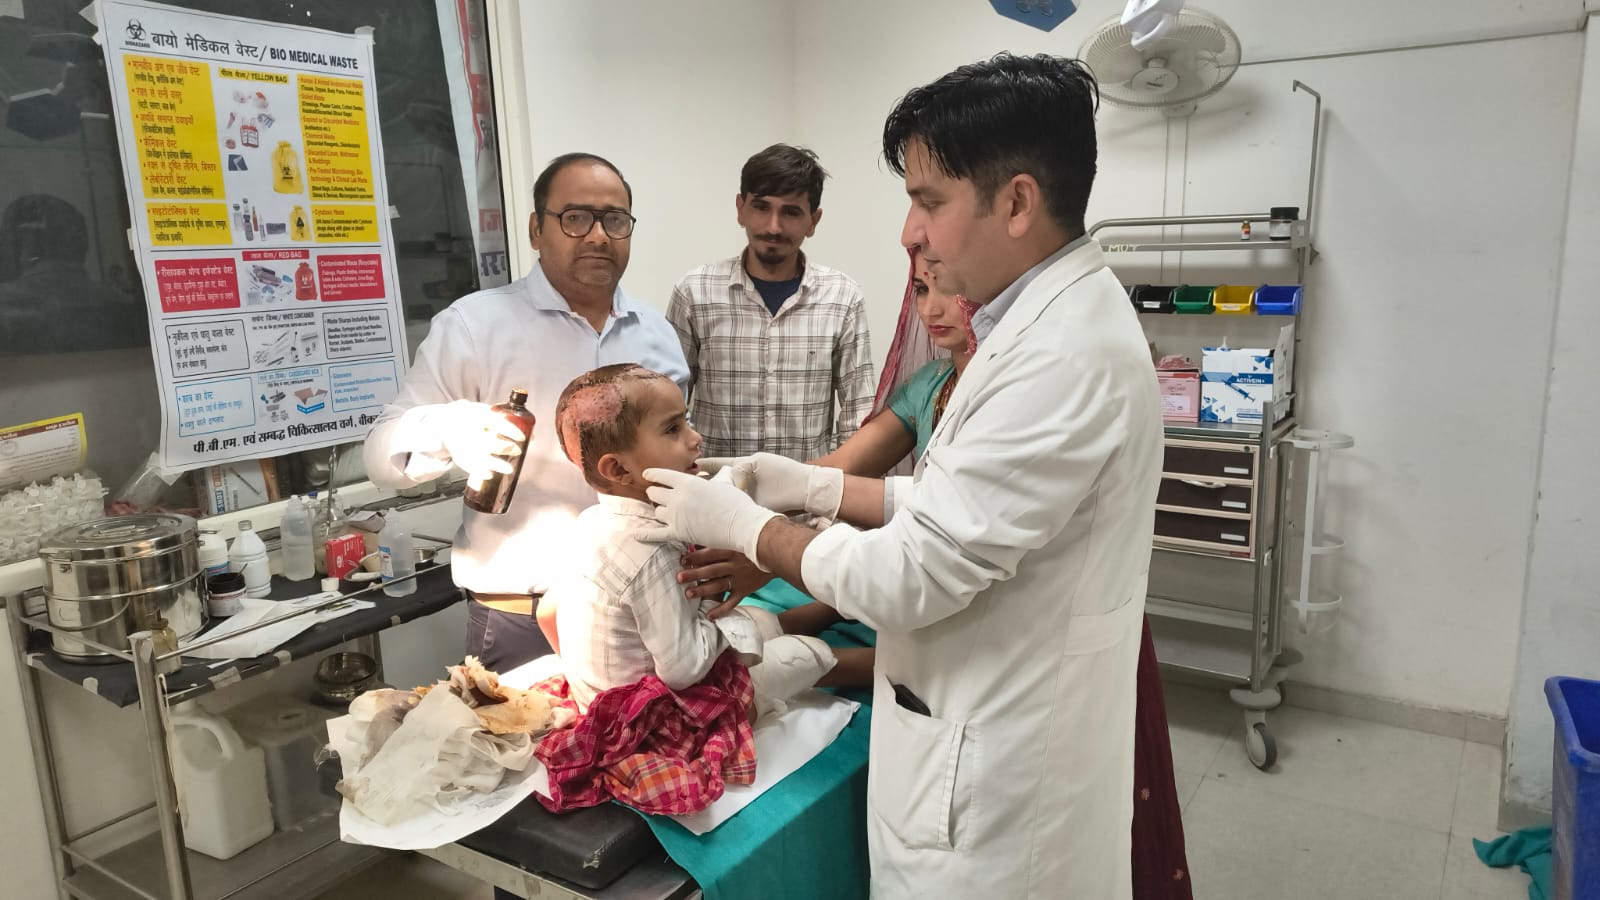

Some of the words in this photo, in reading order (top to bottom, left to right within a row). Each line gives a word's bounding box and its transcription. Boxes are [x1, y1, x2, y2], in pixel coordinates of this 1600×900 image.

[150, 30, 178, 48] बायो
[184, 32, 230, 55] मेडिकल
[270, 47, 286, 60] BIO
[289, 50, 328, 66] MEDICAL
[329, 55, 358, 69] WASTE
[250, 72, 274, 82] YELLOW
[275, 74, 288, 83] BAG
[243, 431, 256, 446] एवं
[287, 422, 338, 438] चिकित्सालय
